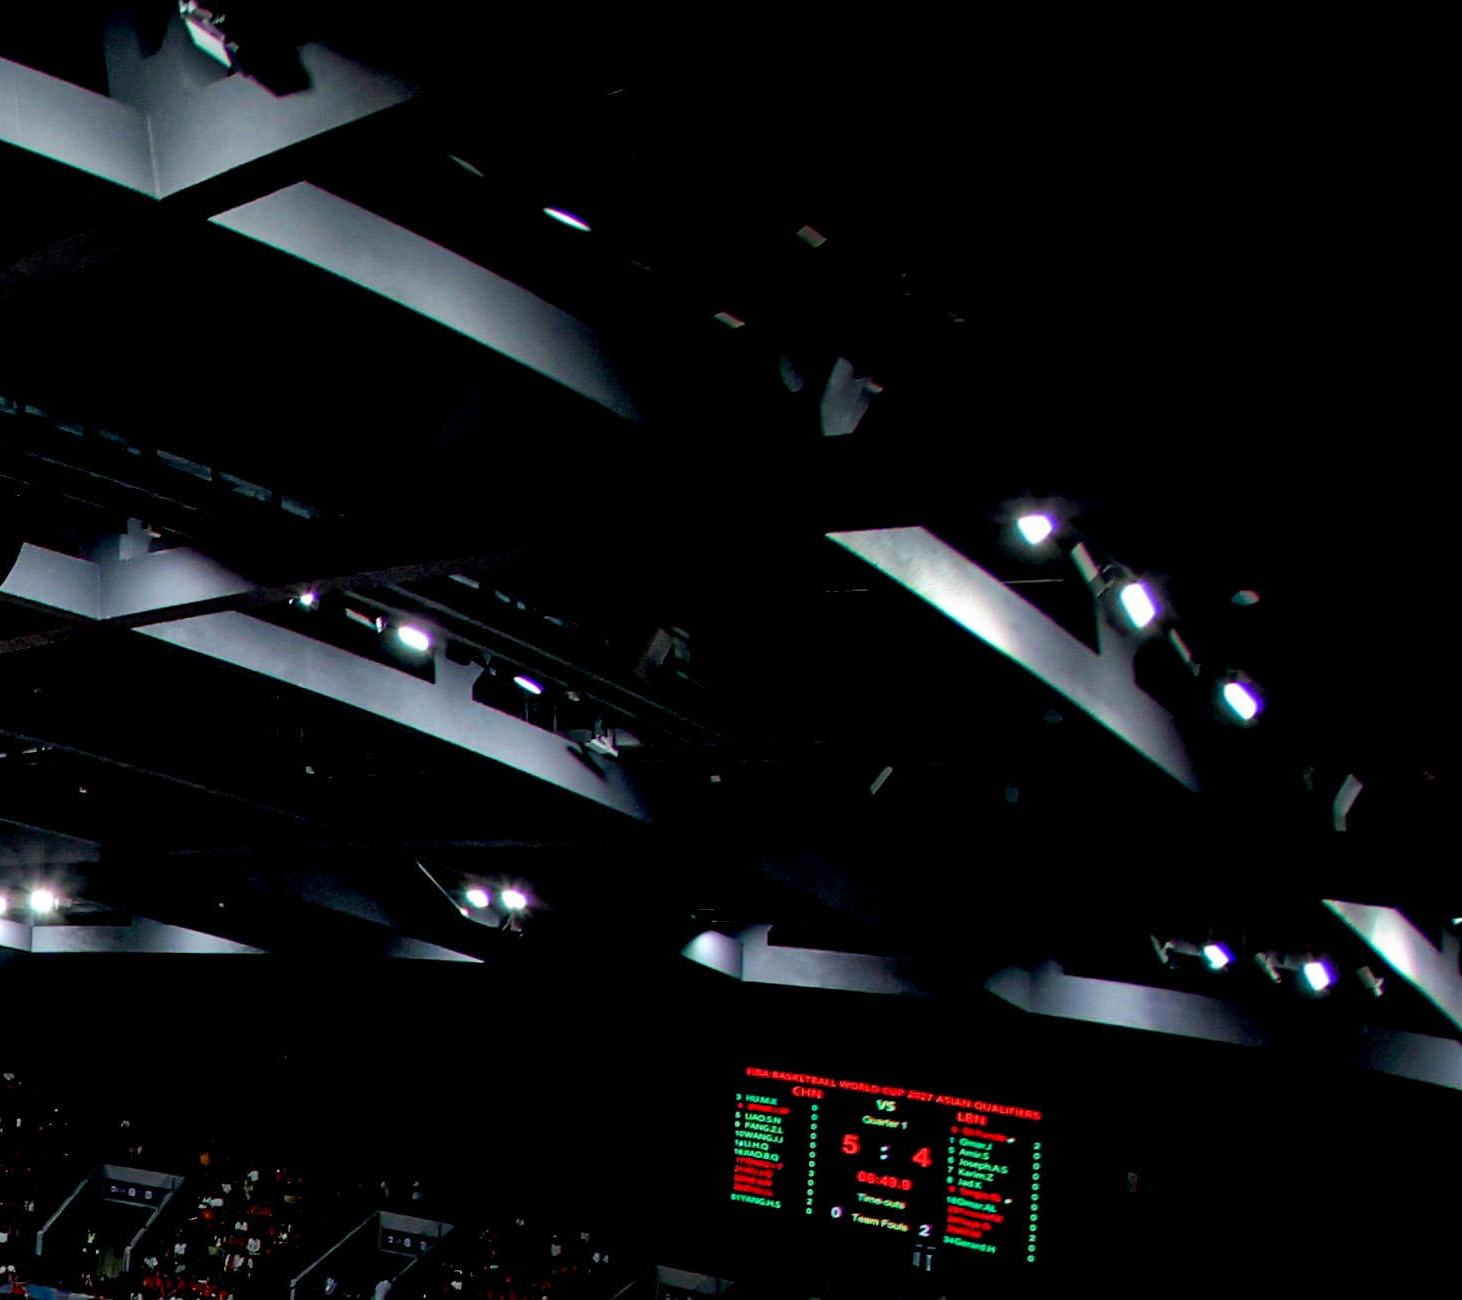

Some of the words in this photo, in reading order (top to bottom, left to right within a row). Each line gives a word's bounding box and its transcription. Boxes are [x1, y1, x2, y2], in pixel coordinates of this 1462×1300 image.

[772, 1070, 837, 1088] BASKETBALL
[839, 1079, 880, 1095] WORLD
[881, 1085, 905, 1098] CUP
[935, 1094, 972, 1109] ASIAN
[974, 1099, 1043, 1121] QUALIFIERS
[791, 1085, 824, 1100] CHN
[876, 1099, 896, 1113] VS
[862, 1115, 900, 1129] Quarter
[956, 1111, 988, 1127] LBN
[840, 1133, 861, 1155] 5
[911, 1147, 933, 1168] 4
[830, 1206, 843, 1218] 0
[851, 1213, 880, 1228] Team
[880, 1219, 910, 1232] Fouls
[918, 1224, 933, 1237] 2
